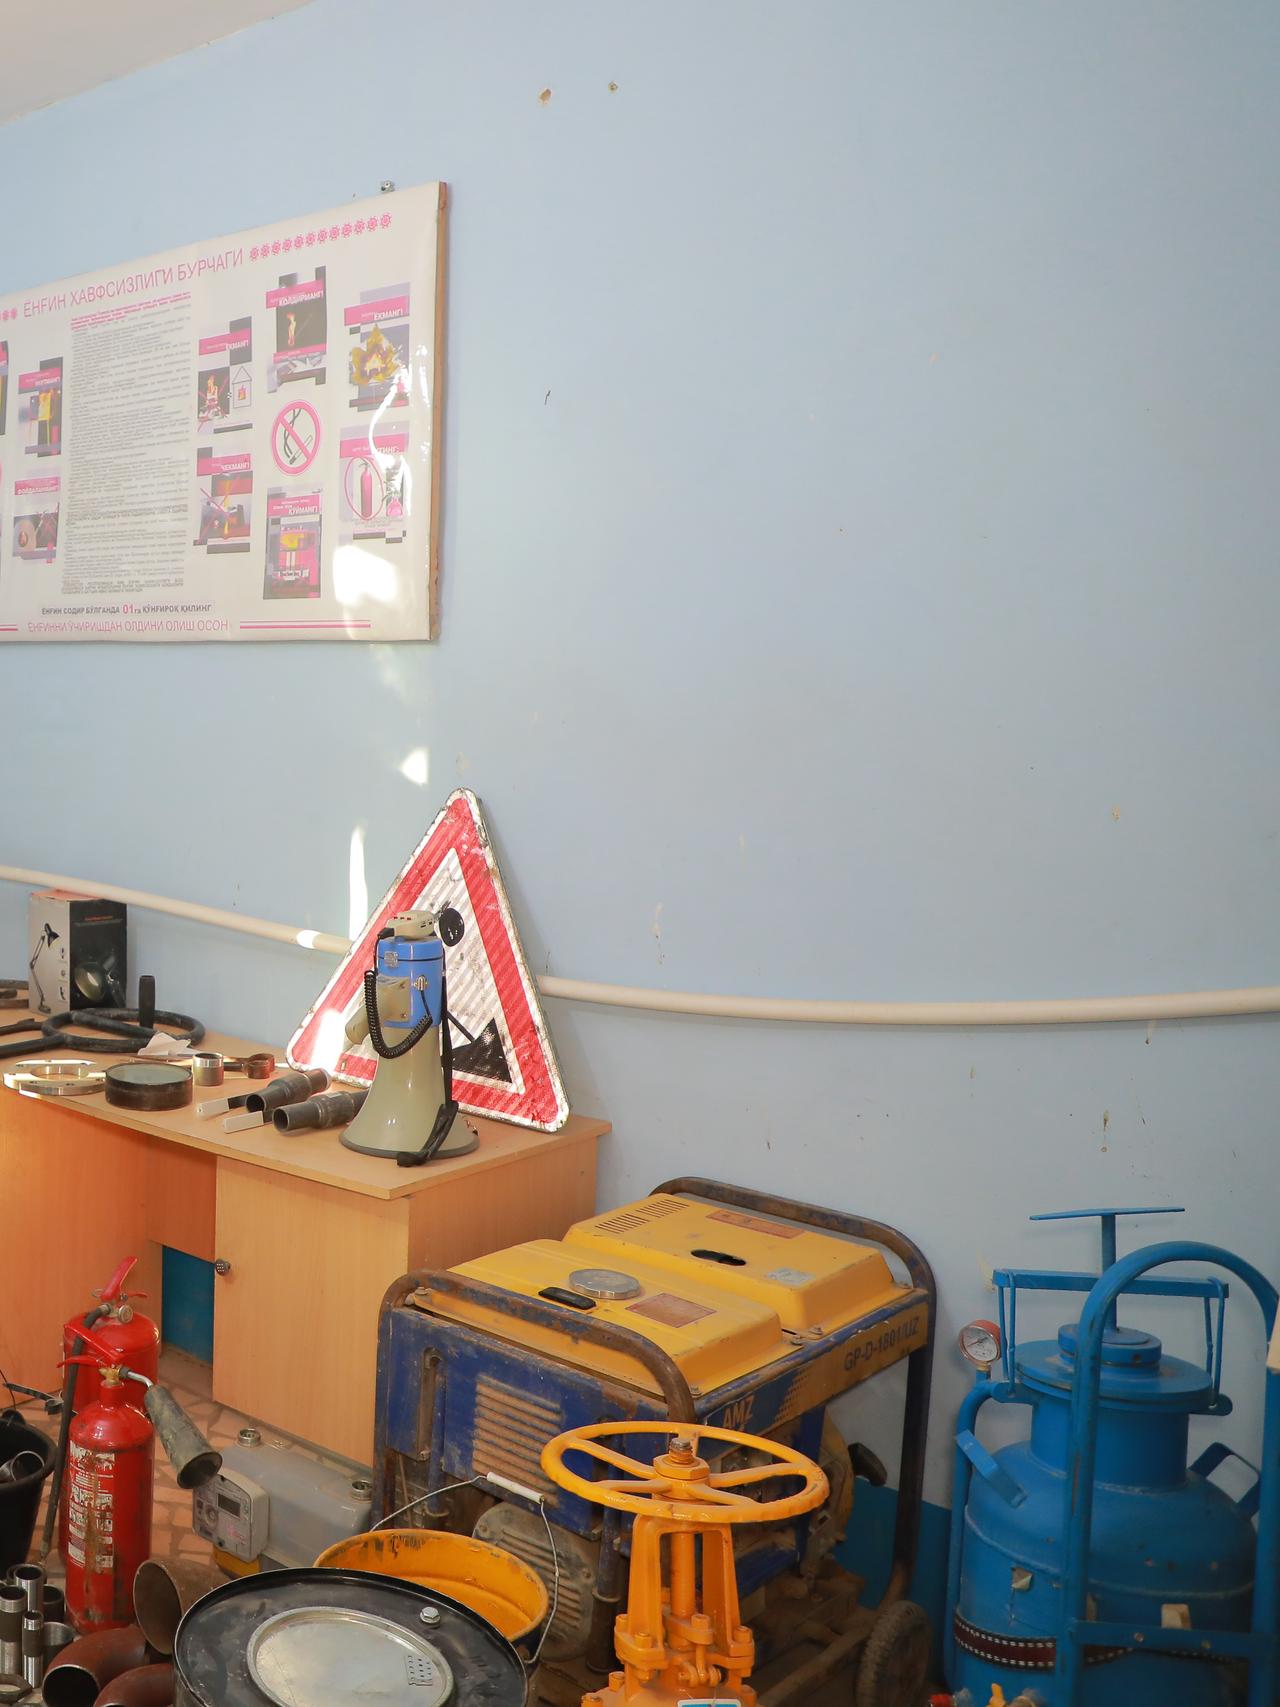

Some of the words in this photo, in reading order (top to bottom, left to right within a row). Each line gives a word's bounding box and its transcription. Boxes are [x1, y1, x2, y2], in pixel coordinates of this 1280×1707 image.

[70, 267, 174, 307] ХАВФСИЗЛИГИ
[177, 248, 244, 281] БУРЧАГИ
[124, 621, 164, 631] ОЛДИНИ
[166, 621, 195, 631] ОЛИШ
[197, 620, 228, 631] ОСОН
